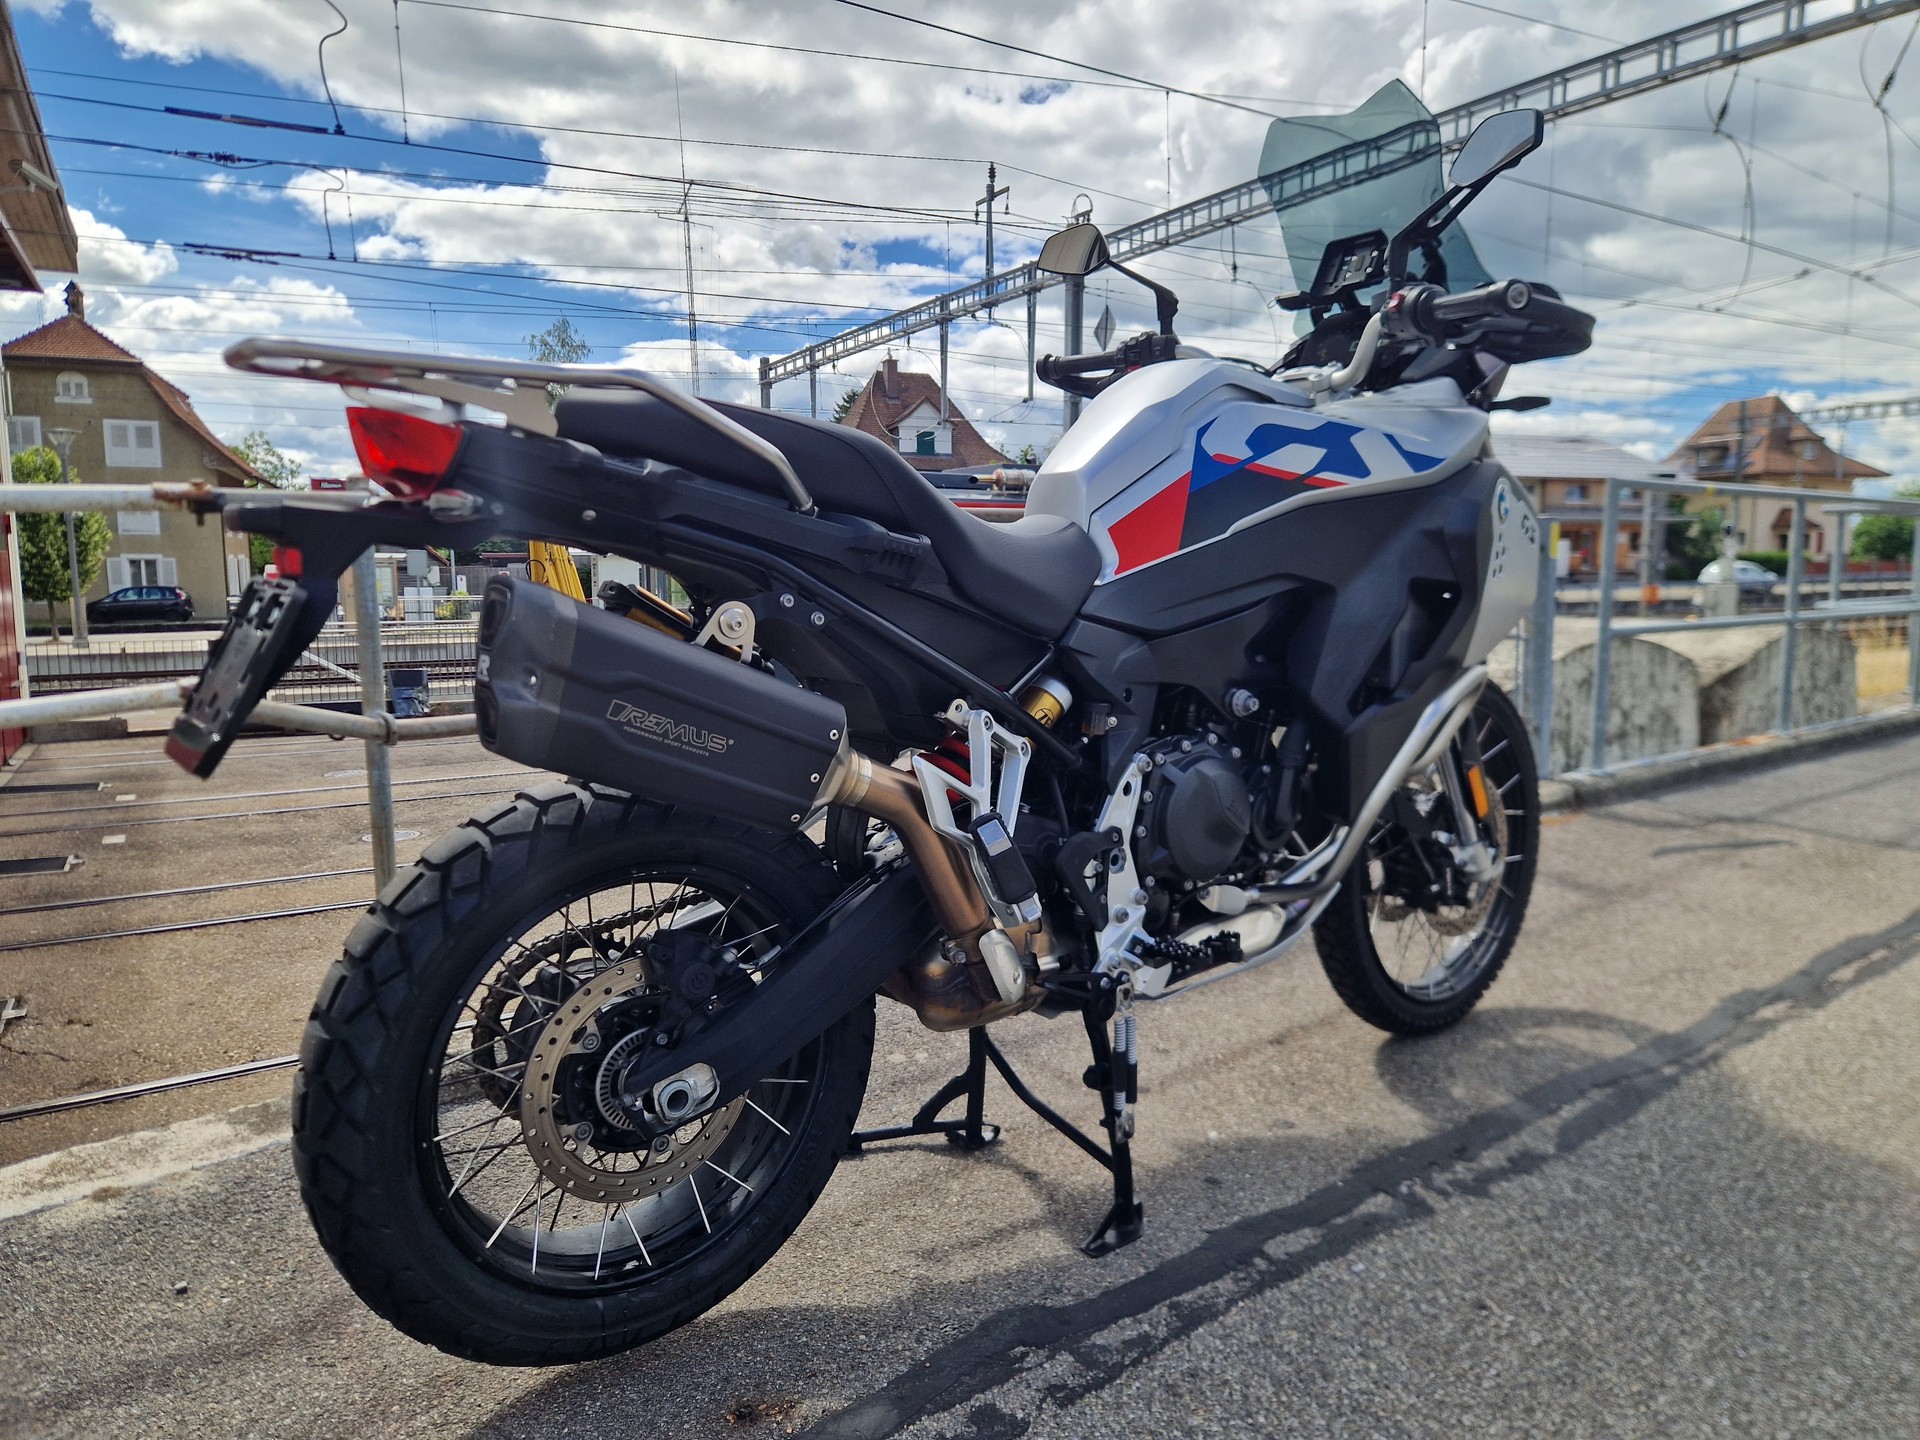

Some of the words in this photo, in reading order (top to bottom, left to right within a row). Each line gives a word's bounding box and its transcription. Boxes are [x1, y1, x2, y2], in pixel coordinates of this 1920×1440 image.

[478, 654, 491, 682] R
[620, 706, 727, 753] REMUS
[623, 725, 664, 742] PERFORMANCE
[664, 738, 682, 748] SPORT
